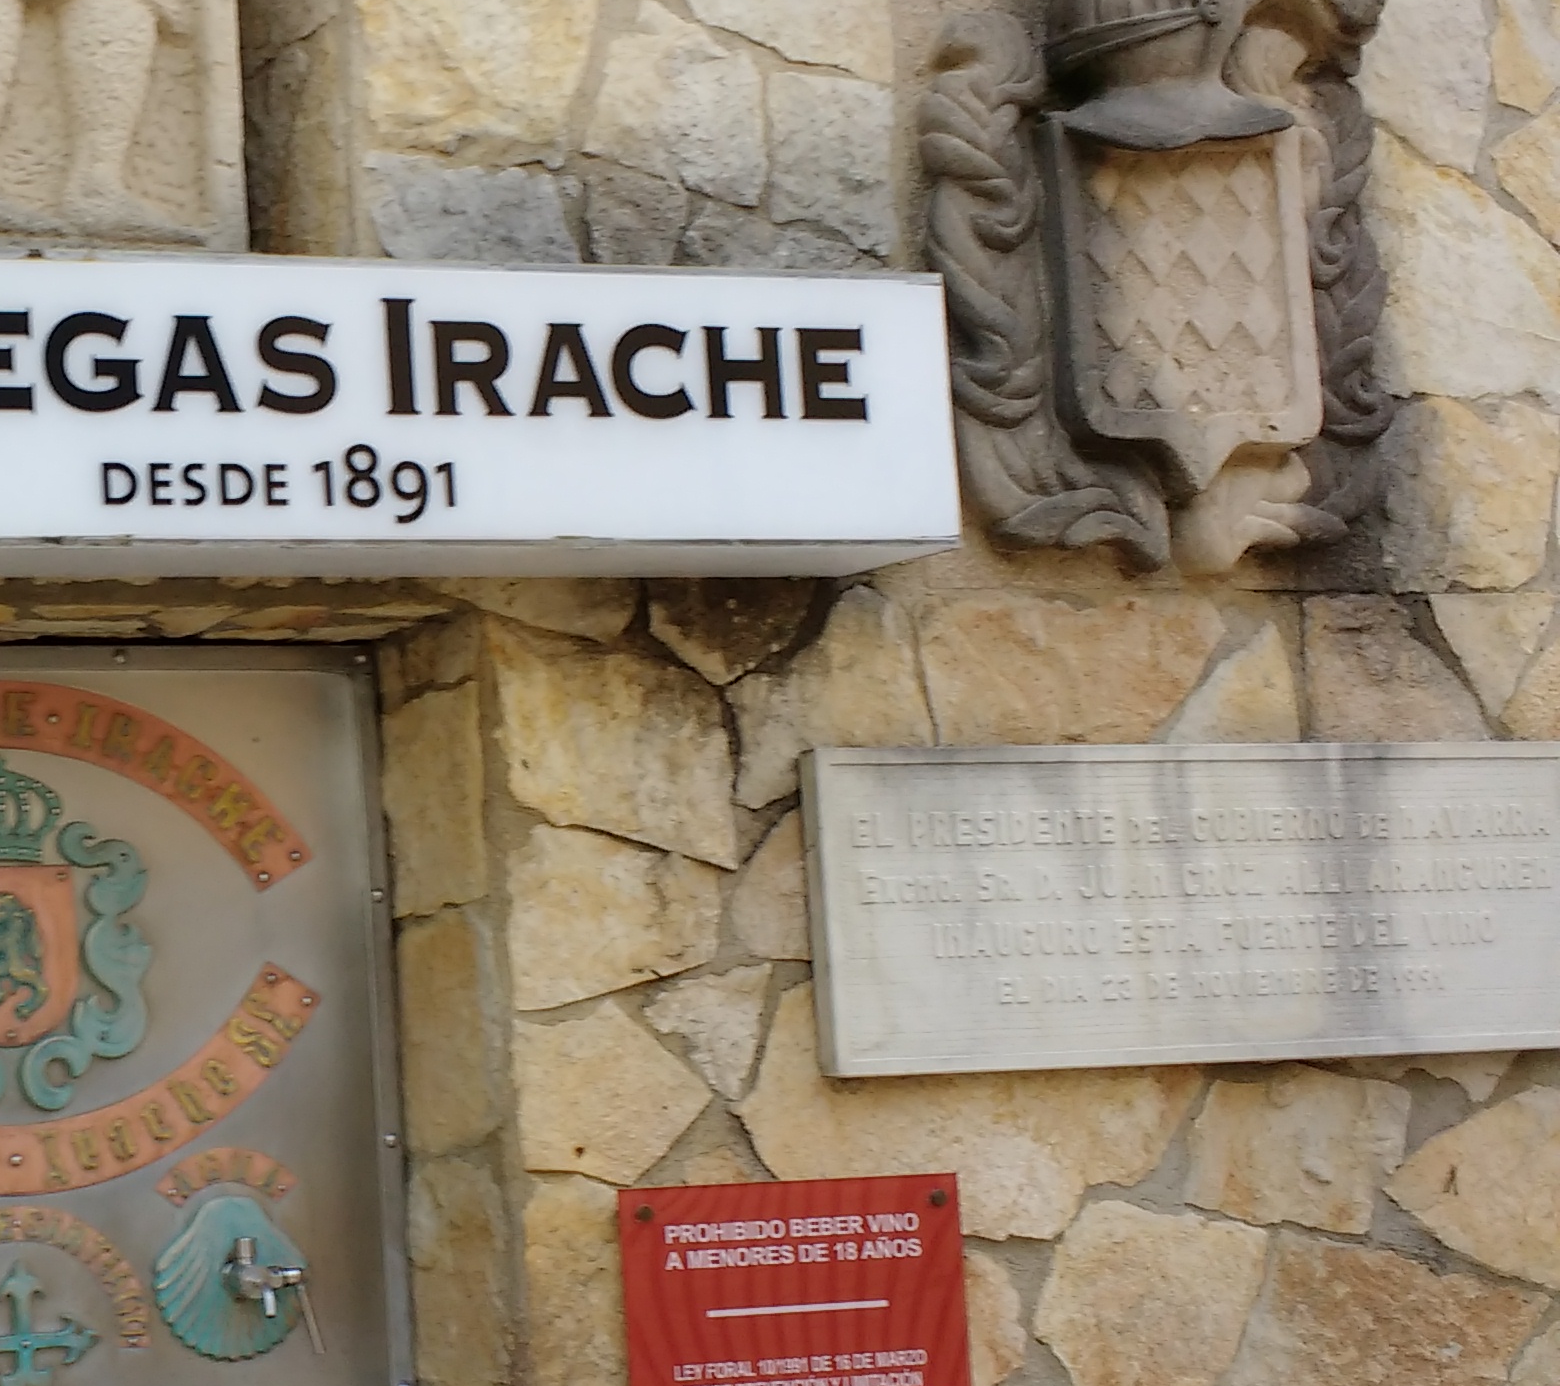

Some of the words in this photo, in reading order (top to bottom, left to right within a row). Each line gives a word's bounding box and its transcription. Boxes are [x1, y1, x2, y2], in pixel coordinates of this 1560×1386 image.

[380, 297, 870, 422] IRACHE
[101, 461, 290, 507] DESDE
[312, 443, 456, 525] 1891
[69, 700, 287, 865] IRACHE
[851, 810, 894, 849] EL
[908, 808, 1116, 848] PRESIDENTE
[1192, 805, 1345, 843] GOBIERNO
[1357, 812, 1390, 839] DE
[1398, 802, 1552, 840] NAVARRA
[1078, 862, 1169, 901] JUAN
[1178, 859, 1264, 898] CRUZ
[1113, 916, 1203, 956] ESTA
[1215, 912, 1340, 953] FUENTE
[1349, 912, 1409, 949] DEL
[1421, 909, 1496, 946] VINO
[997, 975, 1031, 1006] EL
[1146, 970, 1179, 1000] DE
[1192, 966, 1338, 999] NOVIEMBRE
[1348, 964, 1380, 995] DE
[664, 1219, 786, 1244] PROHIBIDO
[789, 1215, 864, 1238] BEBER
[866, 1212, 920, 1233] VINO
[664, 1251, 685, 1270] A
[687, 1245, 795, 1269] MENORES
[798, 1243, 830, 1263] DE
[833, 1241, 858, 1261] 18
[860, 1237, 923, 1260] AÑOS
[673, 1363, 704, 1381] LEY
[810, 1355, 833, 1372] DE
[852, 1352, 875, 1369] DE
